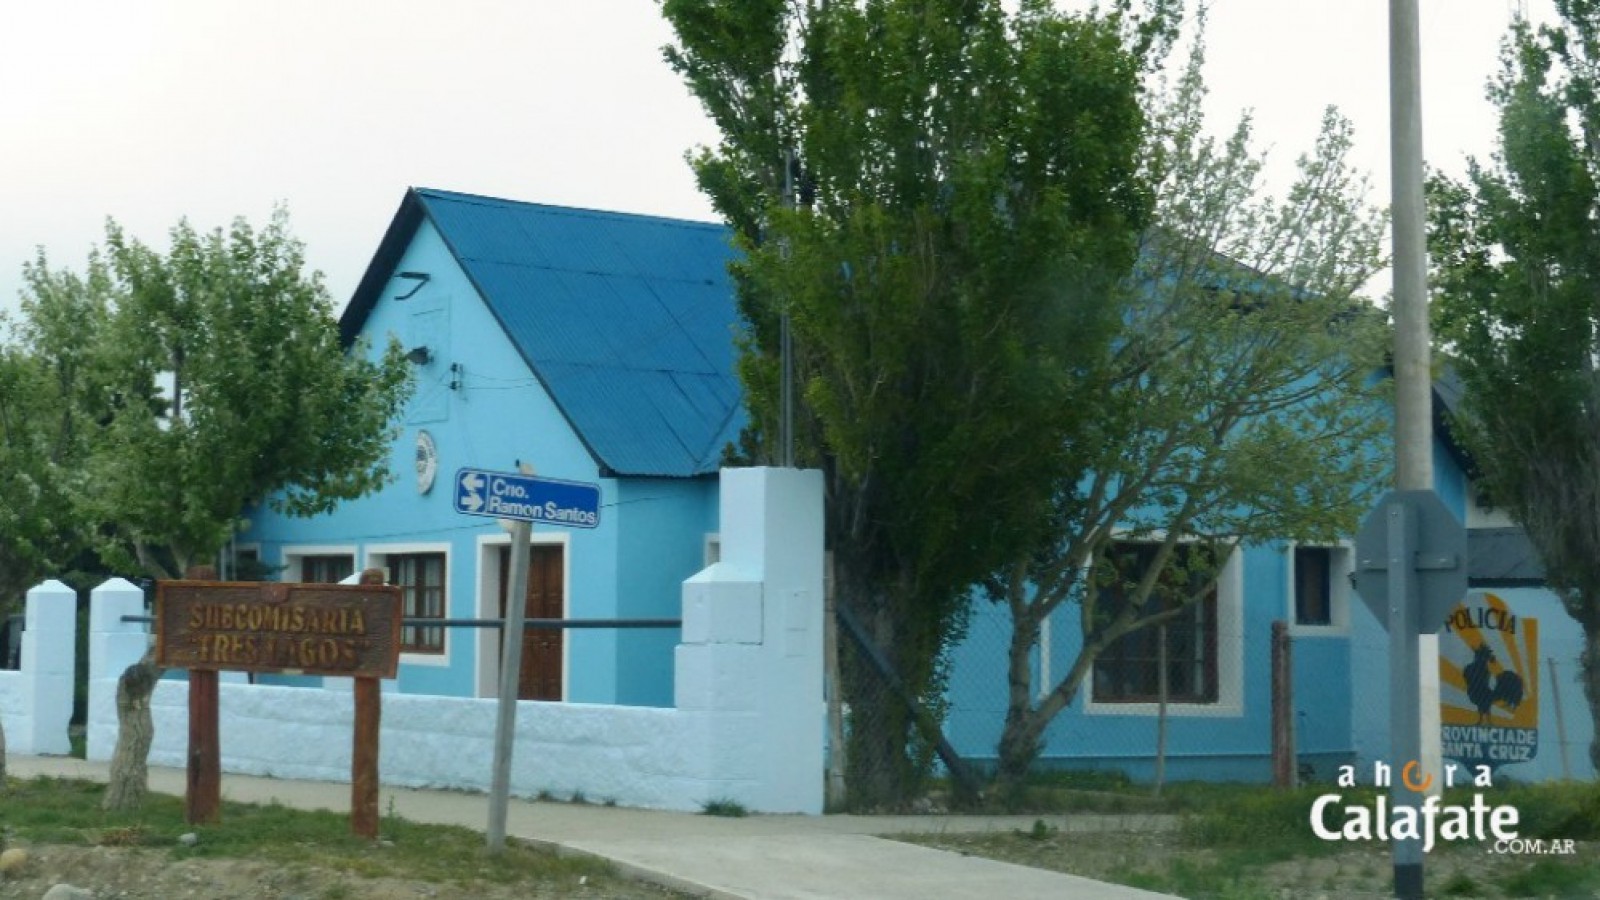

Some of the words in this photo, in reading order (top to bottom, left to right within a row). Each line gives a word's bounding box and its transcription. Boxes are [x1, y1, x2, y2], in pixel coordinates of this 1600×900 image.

[489, 497, 542, 518] Ramon
[545, 501, 596, 524] Santos
[189, 603, 365, 634] SUBCOMISARIA
[1445, 606, 1517, 635] POLICIA
[1488, 744, 1531, 761] CRUZ
